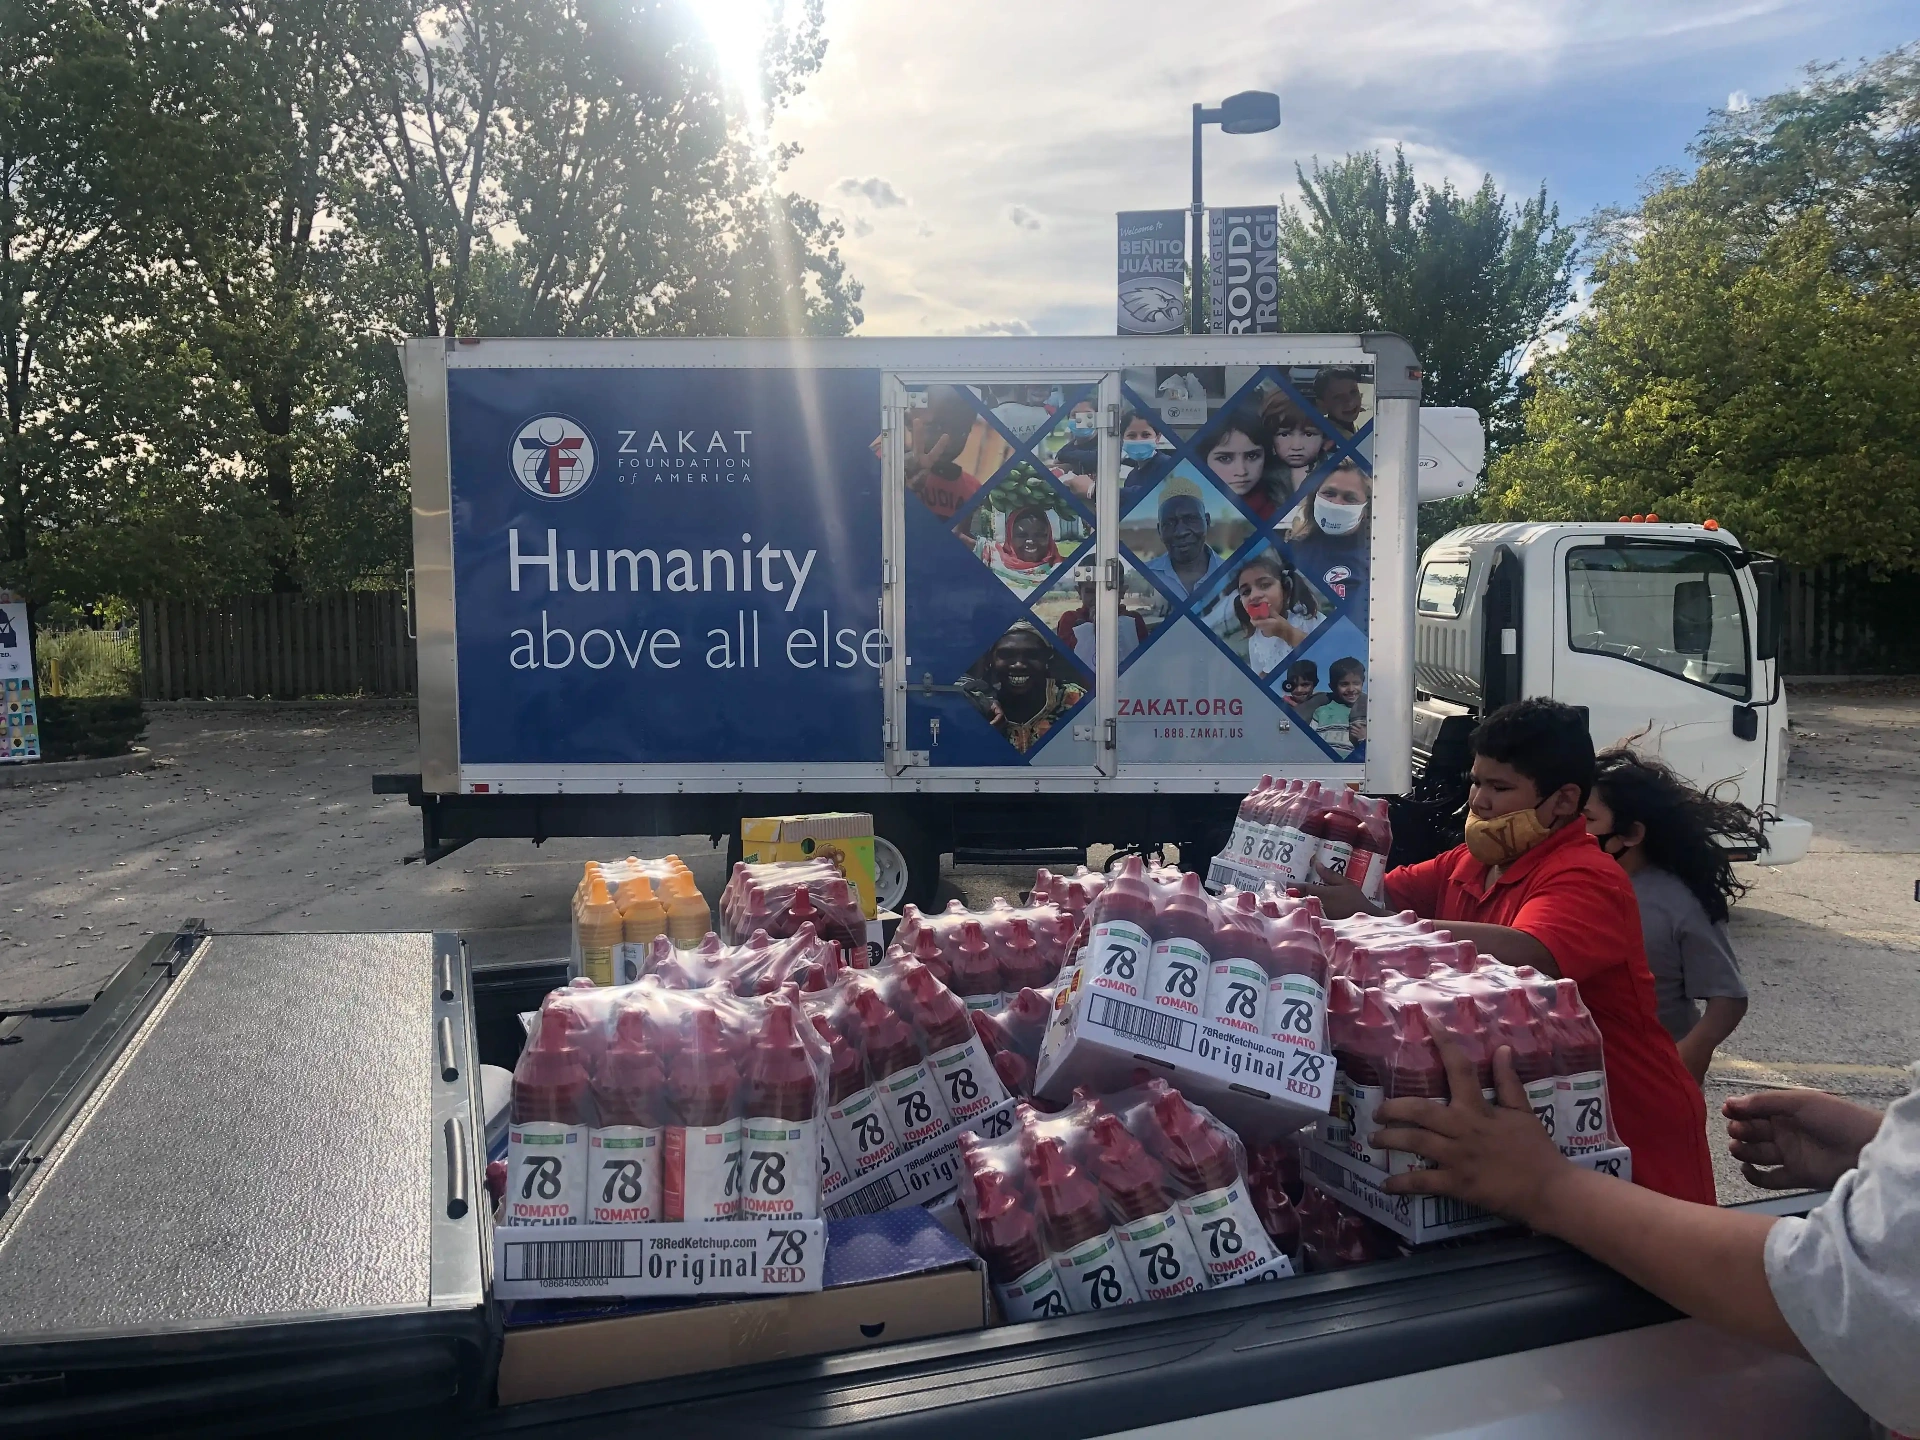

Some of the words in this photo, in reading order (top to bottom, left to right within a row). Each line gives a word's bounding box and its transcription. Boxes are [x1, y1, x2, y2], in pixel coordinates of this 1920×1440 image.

[1120, 224, 1155, 237] Welcome
[1156, 221, 1163, 231] to
[1120, 240, 1184, 255] BENITO
[1213, 217, 1223, 287] EAGLES
[1118, 255, 1185, 273] JUÁREZ
[1227, 214, 1252, 334] ROUD!
[617, 430, 752, 453] ZAKAT
[618, 458, 751, 468] FOUNDATION
[618, 472, 638, 485] of
[654, 473, 751, 483] AMERICA
[509, 527, 818, 612] Humanity
[509, 609, 682, 670] above
[705, 609, 759, 670] all
[1117, 698, 1243, 716] ZAKAT.ORG
[1153, 728, 1244, 738] 1.888.ZAKAT.US
[1258, 838, 1276, 861] 78
[1275, 840, 1294, 864] 78
[1103, 943, 1138, 980] 78
[1095, 977, 1137, 997] TOMATO
[1164, 961, 1199, 998] 78
[1155, 995, 1199, 1015] TOMATO
[1225, 981, 1259, 1019] 78
[1215, 1016, 1260, 1034] TOMATO
[1281, 997, 1314, 1034] 78
[1202, 1025, 1285, 1059] 78RedKetchup.com
[1271, 1033, 1316, 1051] TOMATO
[1198, 1037, 1284, 1081] Original
[1289, 1048, 1325, 1083] 78
[944, 1068, 979, 1104] 78
[1285, 1077, 1321, 1100] RED
[897, 1090, 932, 1128] 78
[952, 1095, 991, 1116] TOMATO
[1574, 1097, 1603, 1132] 78
[851, 1112, 885, 1152] 78
[903, 1118, 943, 1141] TOMATO
[982, 1109, 1013, 1139] 78
[856, 1141, 895, 1167] TOMATO
[904, 1140, 959, 1172] 78RedKetchup
[521, 1155, 562, 1200] 78
[602, 1159, 643, 1204] 78
[749, 1150, 786, 1196] 78
[909, 1153, 960, 1191] Origi
[513, 1203, 570, 1217] TOMATO
[594, 1207, 650, 1221] TOMATO
[744, 1197, 794, 1212] TOMATO
[649, 1236, 757, 1250] 78RedKetchup.com
[764, 1228, 808, 1266] 78
[1201, 1216, 1243, 1259] 78
[648, 1251, 757, 1285] Original
[761, 1266, 806, 1283] RED
[1138, 1242, 1181, 1285] 78
[1208, 1250, 1257, 1273] TOMATO
[1081, 1264, 1123, 1310] 78
[1145, 1276, 1195, 1300] TOMATO
